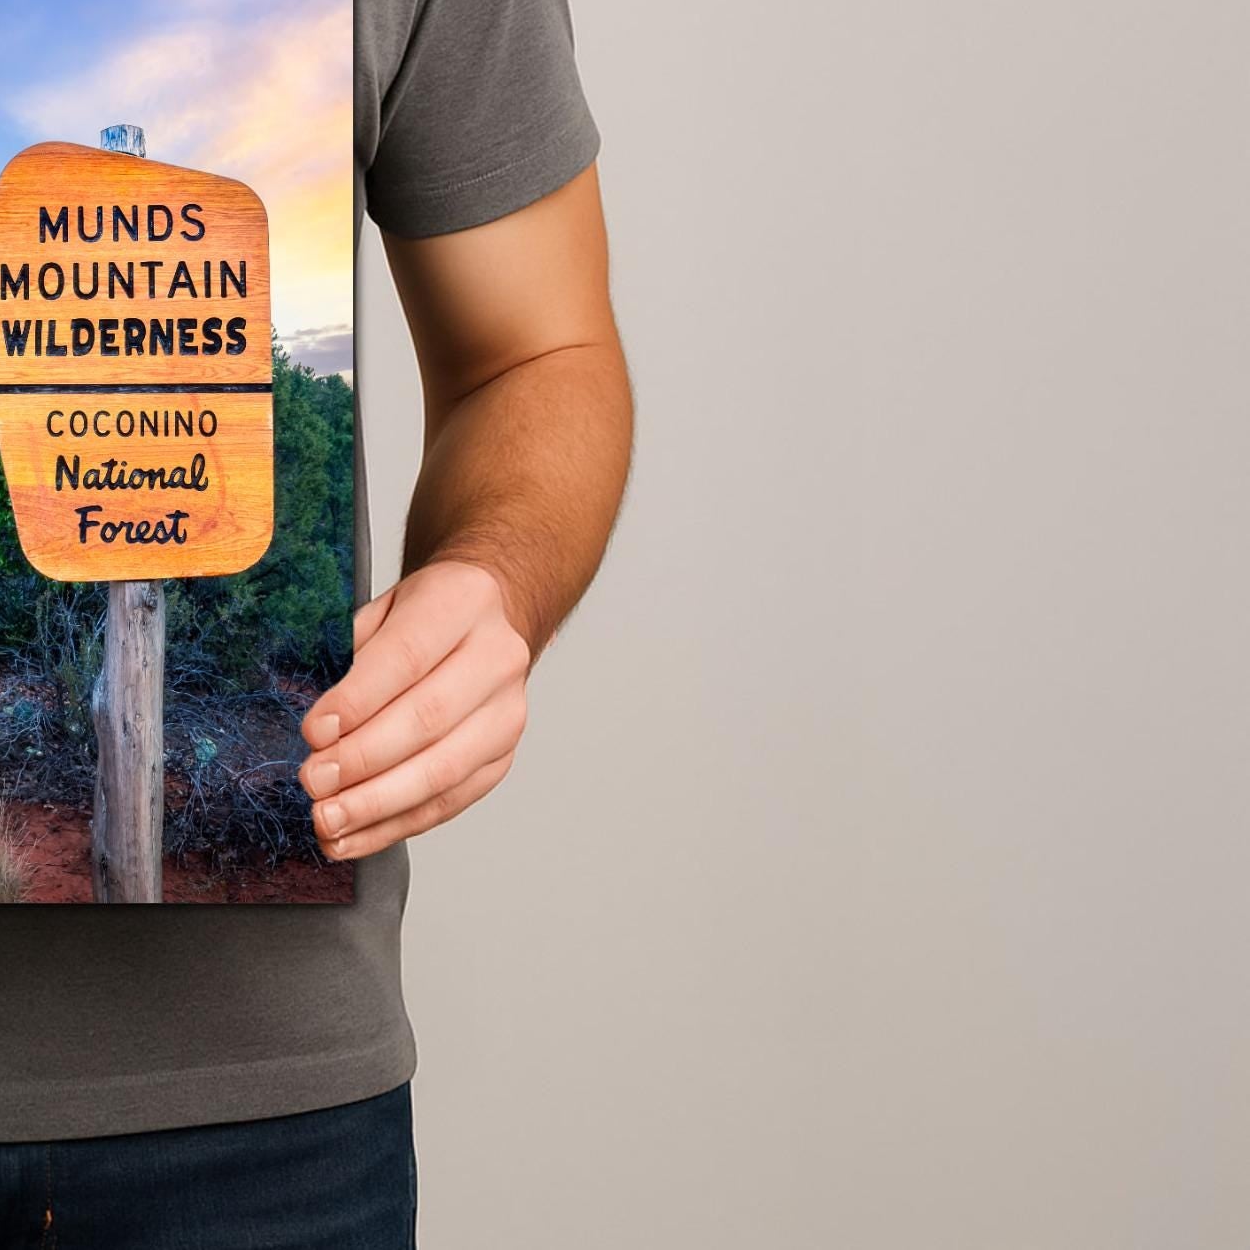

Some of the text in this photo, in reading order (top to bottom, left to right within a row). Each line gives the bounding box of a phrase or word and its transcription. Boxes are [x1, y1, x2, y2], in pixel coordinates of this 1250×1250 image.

[39, 203, 206, 243] MUNDS
[0, 260, 247, 301] MOUNTAIN
[1, 316, 247, 357] WILDERNESS
[46, 410, 218, 438] COCONINO
[55, 453, 209, 492] National
[74, 504, 188, 545] Forest
